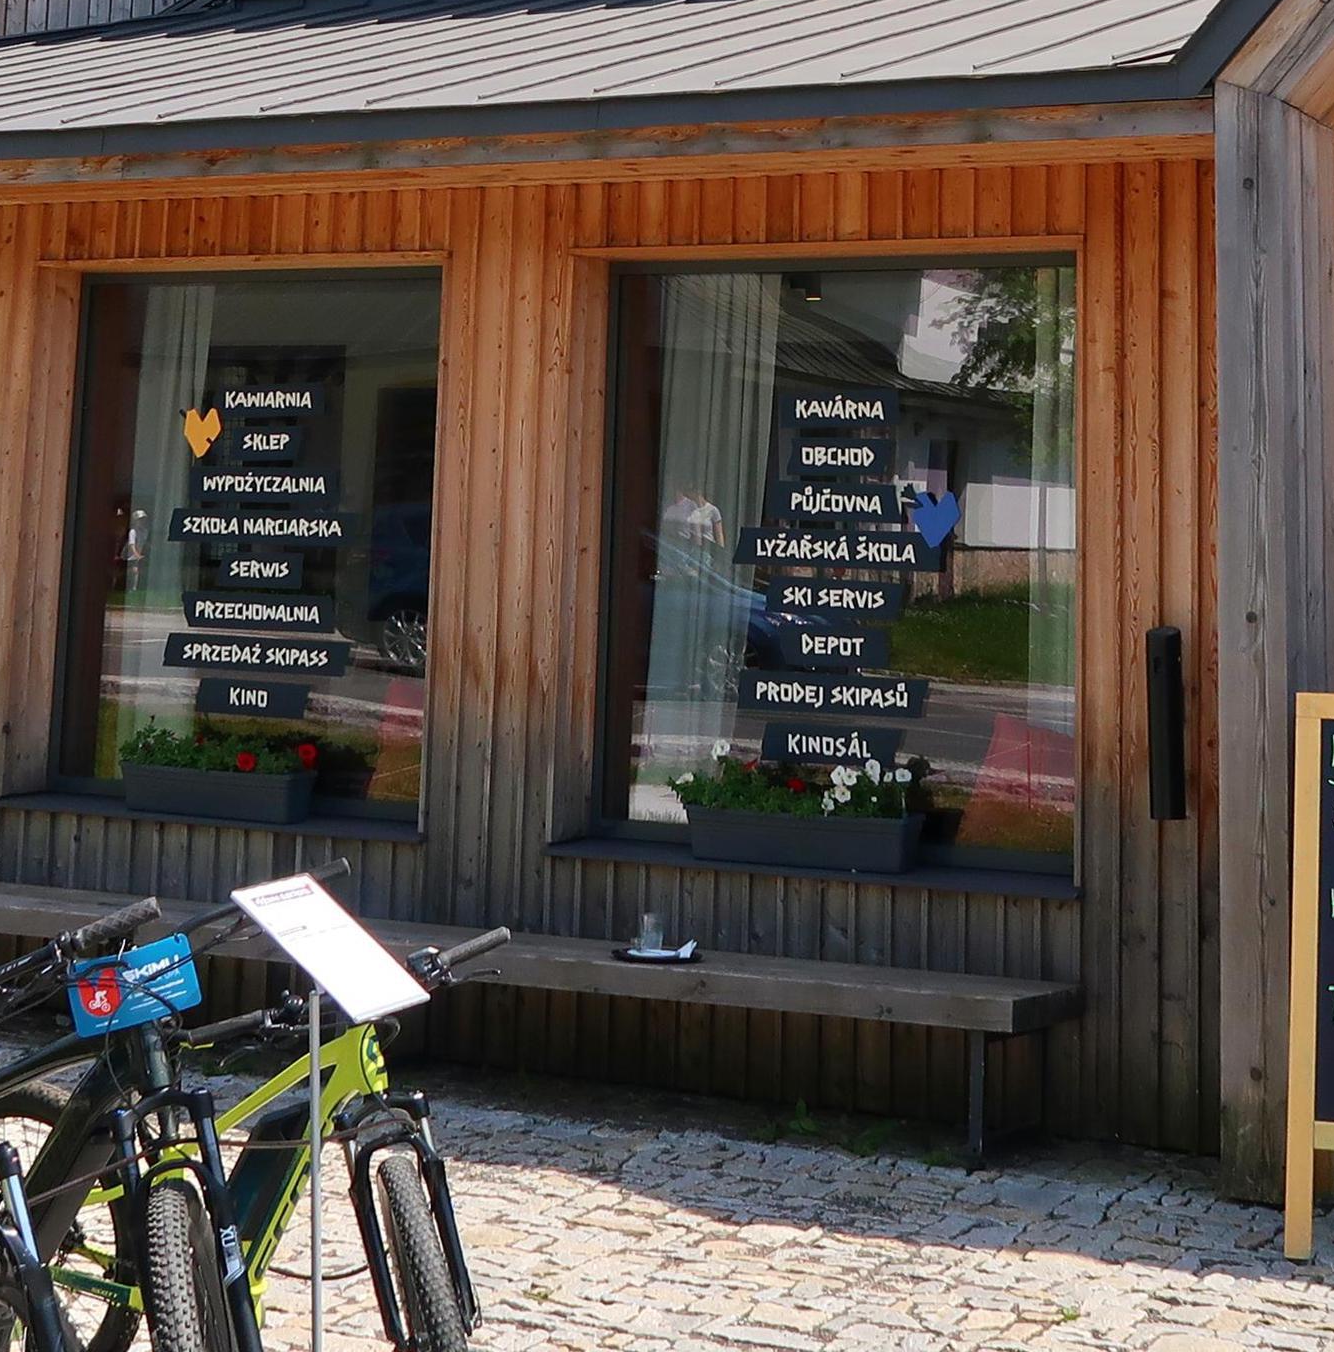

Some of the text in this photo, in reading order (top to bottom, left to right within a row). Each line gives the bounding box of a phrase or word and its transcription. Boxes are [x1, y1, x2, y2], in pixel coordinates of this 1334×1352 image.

[225, 390, 311, 409] KAWIARNIA
[795, 395, 884, 420] KAVÁRNA
[243, 433, 290, 451] SKLEP
[802, 447, 874, 467] OBCHOD
[203, 472, 325, 494] WYPOŻYCZALNIA
[791, 486, 882, 515] PŮJČOVNA
[182, 516, 342, 537] SZKOŁA NARCIARSKA
[756, 533, 916, 564] LYŽAŘSKÁ ŠKOLA
[229, 560, 289, 578] SERWIS
[782, 586, 885, 609] SKI SERVIS
[195, 601, 319, 624] PRZECHOWALNIA
[183, 643, 328, 667] SPRZEDAŻ SKIPASS
[801, 633, 864, 656] DEPOT
[229, 687, 268, 708] KINO
[756, 681, 908, 708] PRODEJ SKIPASŮ
[788, 731, 871, 759] KINOSÁL
